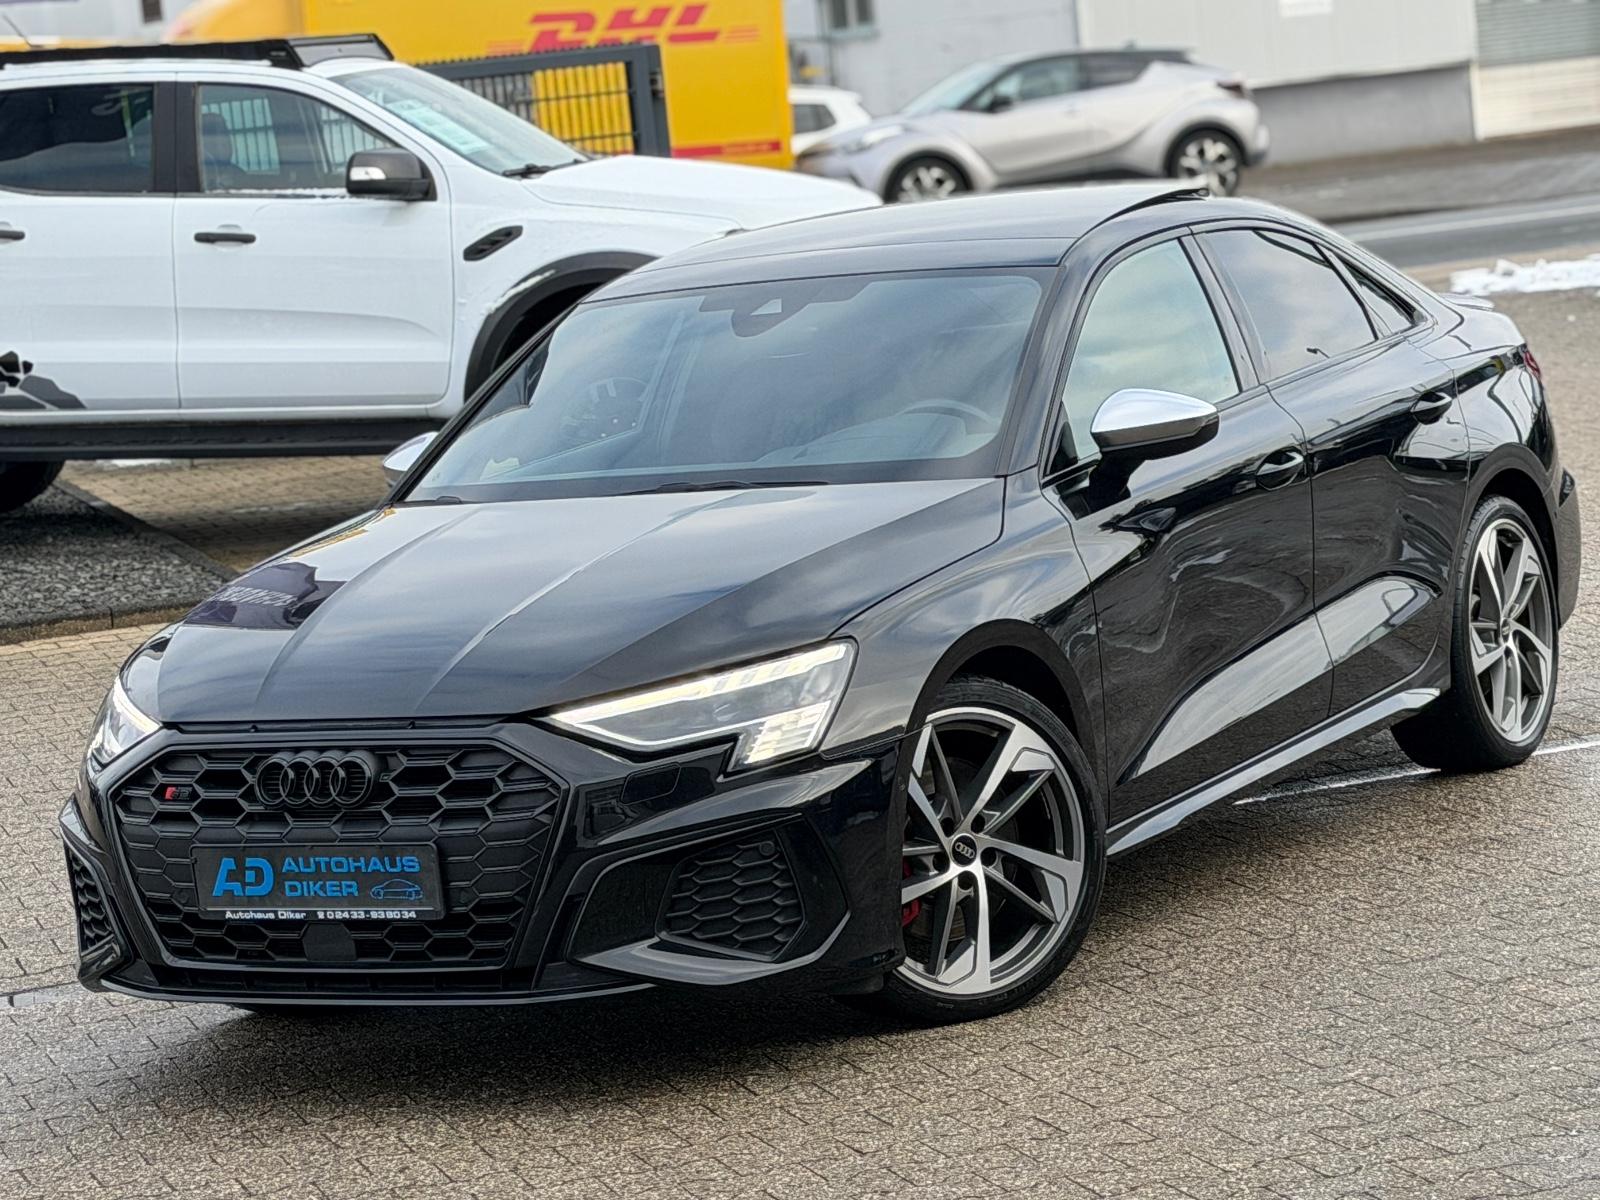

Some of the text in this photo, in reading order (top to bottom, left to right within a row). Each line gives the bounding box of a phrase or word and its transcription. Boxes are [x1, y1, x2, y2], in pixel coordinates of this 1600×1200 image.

[527, 4, 721, 53] DHL
[282, 855, 421, 874] AUTOHAUS
[212, 857, 275, 897] AD
[284, 880, 359, 897] DIKER
[225, 910, 275, 919] Autohaus
[278, 910, 306, 919] Diker
